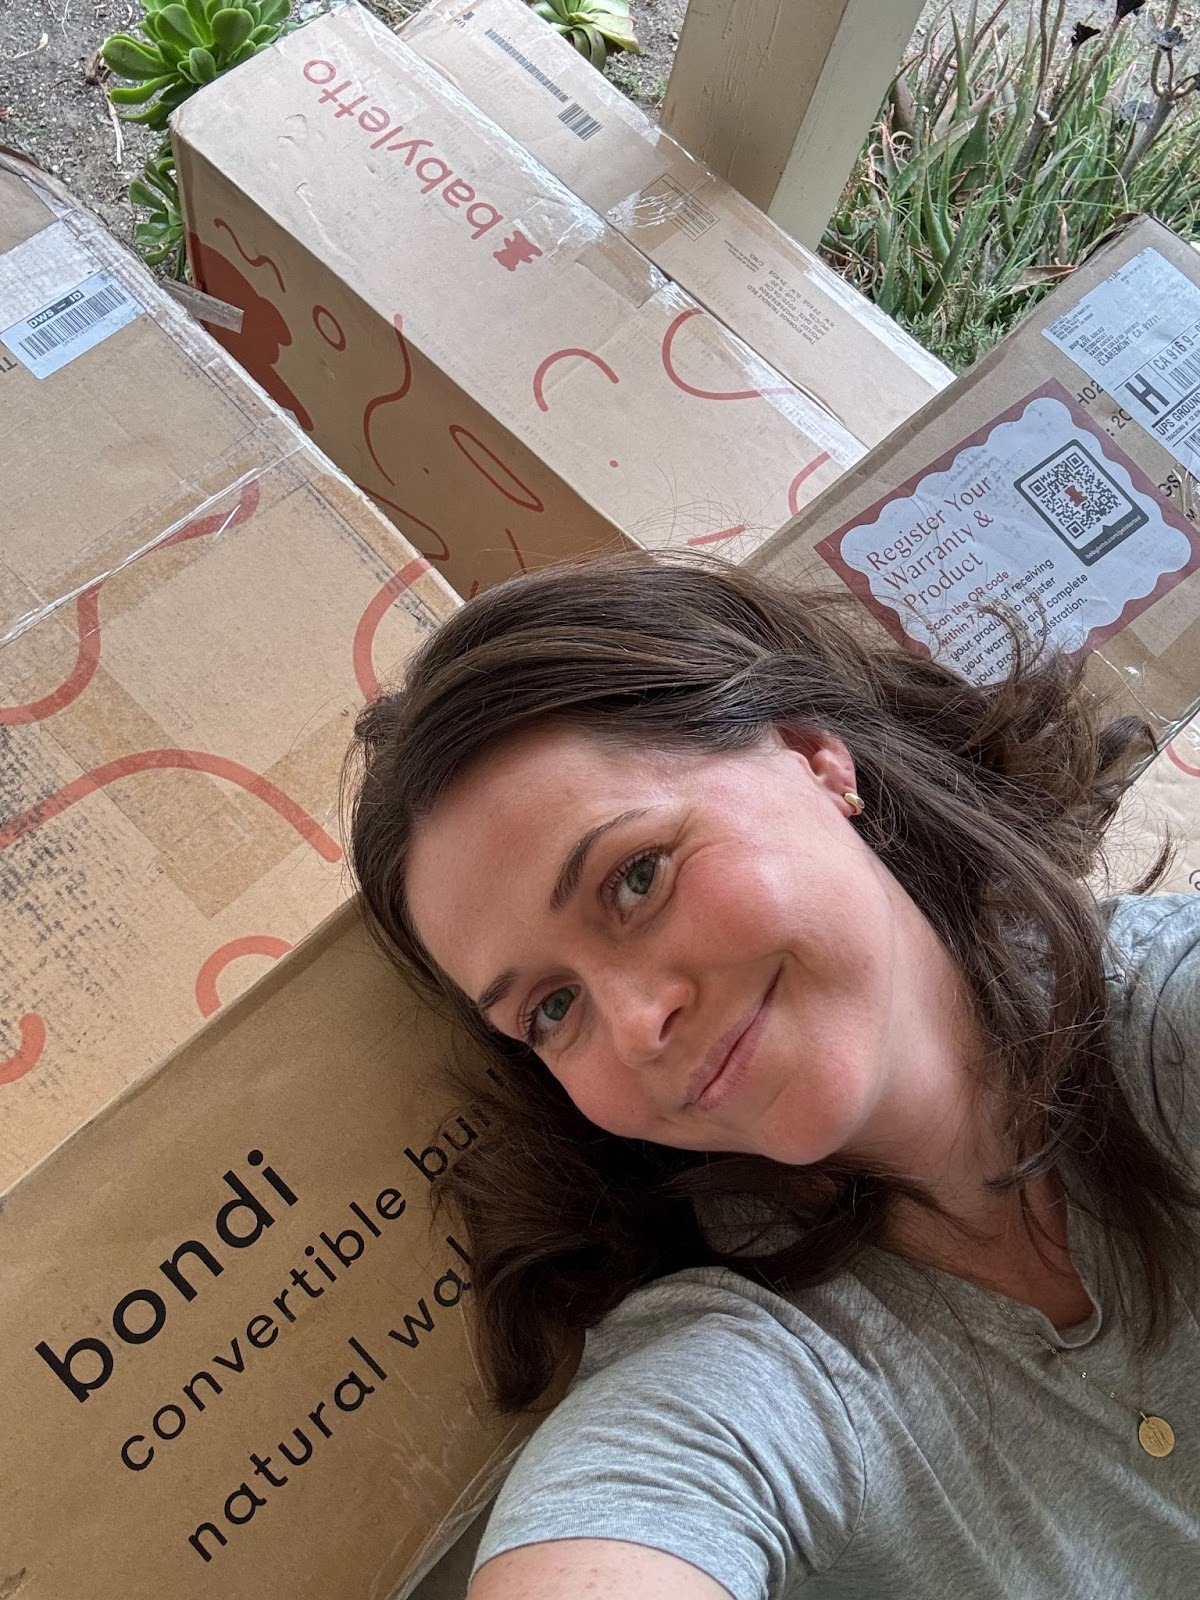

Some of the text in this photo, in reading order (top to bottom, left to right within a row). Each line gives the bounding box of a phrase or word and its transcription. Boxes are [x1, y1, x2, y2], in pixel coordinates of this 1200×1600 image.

[302, 58, 504, 240] babyletto
[29, 308, 54, 328] DWS
[69, 292, 82, 302] ID
[746, 284, 815, 345] TWIN STORAGE TRUNDLE BED
[812, 324, 826, 336] MFG
[1079, 337, 1090, 348] KATE
[1088, 345, 1100, 356] KATE
[1097, 337, 1132, 366] CLAREMONT
[1132, 328, 1143, 338] CA
[1142, 315, 1160, 330] 91711
[1153, 356, 1172, 370] CA
[1166, 342, 1187, 360] 916
[1124, 374, 1170, 416] H
[1156, 418, 1176, 436] UPS
[1165, 424, 1186, 442] TRACKING
[866, 476, 992, 571] Register Your
[882, 510, 994, 590] Warranty &
[1085, 515, 1142, 560] babyletto.com/getstarted
[902, 552, 984, 611] Product
[926, 571, 1010, 634] Scan the QR code
[940, 622, 970, 646] within
[967, 614, 976, 624] 7
[1001, 588, 1012, 600] of
[1011, 558, 1054, 593] receiving
[950, 640, 975, 662] your
[1022, 576, 1056, 606] register
[962, 654, 985, 675] your
[1028, 604, 1046, 622] and
[1046, 573, 1088, 608] complete
[973, 666, 996, 686] your
[35, 1149, 298, 1404] bondi
[121, 1188, 406, 1472] convertible
[188, 1336, 388, 1562] natural
